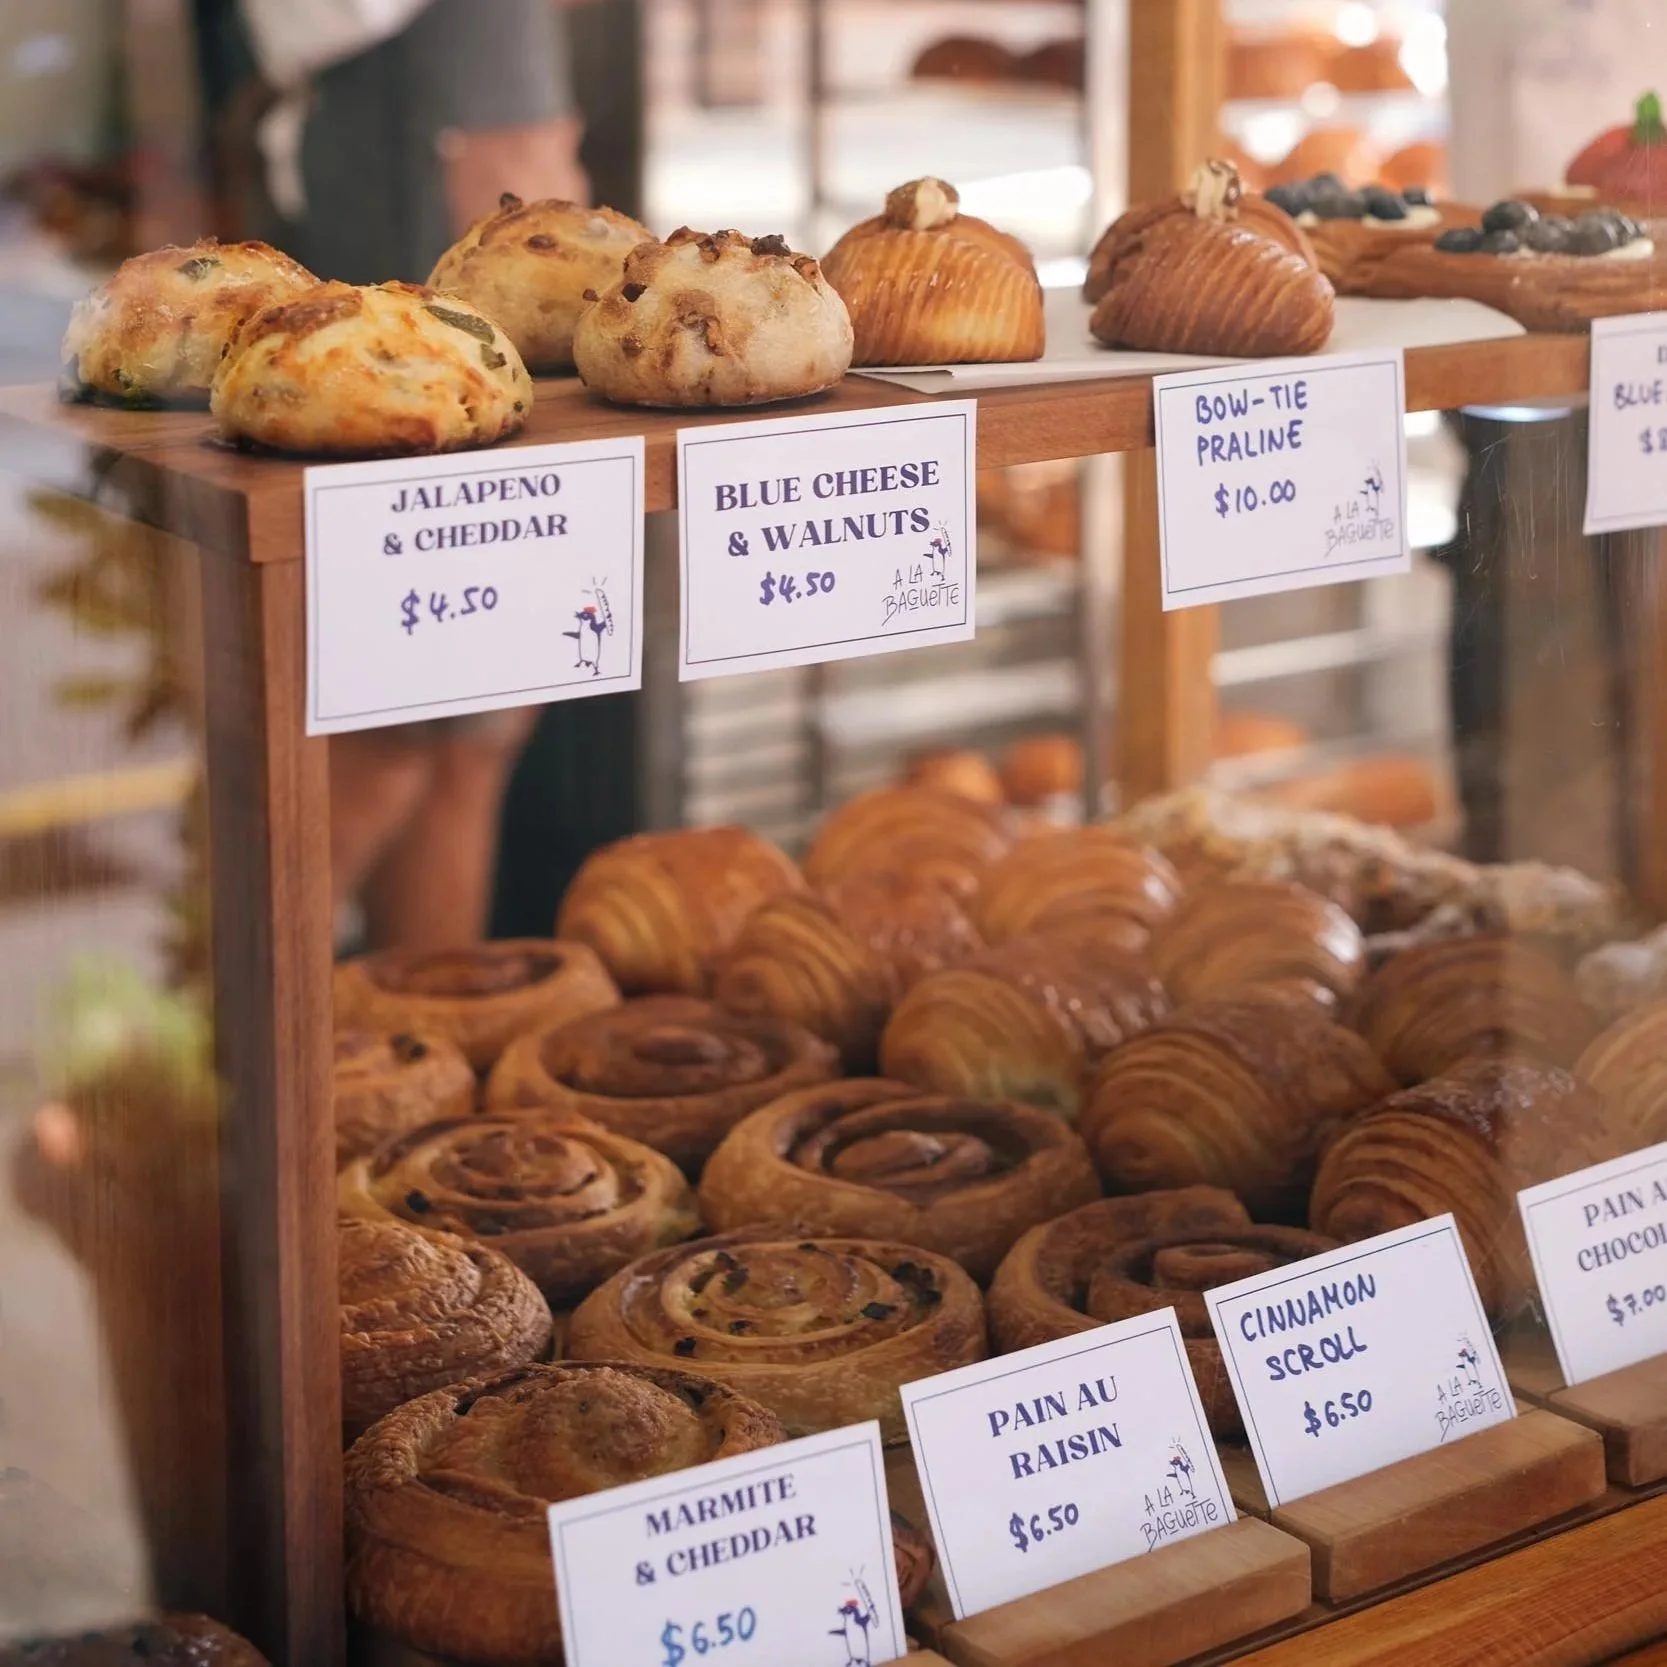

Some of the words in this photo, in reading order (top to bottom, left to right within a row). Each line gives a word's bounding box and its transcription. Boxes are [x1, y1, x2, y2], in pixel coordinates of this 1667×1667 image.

[1195, 381, 1308, 424] BOW-TIE
[1614, 380, 1667, 410] BLUE
[1197, 419, 1303, 466] PRALINE
[390, 473, 561, 513] JALAPENO
[715, 476, 801, 511] BLUE
[812, 460, 940, 498] CHEESE
[1214, 480, 1296, 518] $10.00
[383, 533, 403, 556] &
[414, 514, 568, 552] CHEDDAR
[728, 531, 749, 556] &
[761, 507, 930, 551] WALNUTS
[1334, 505, 1342, 522] A
[1346, 502, 1360, 520] LA
[759, 571, 836, 606] $4.50
[893, 568, 903, 589] A
[909, 564, 923, 584] LA
[401, 585, 498, 635] $4.50
[1583, 1188, 1645, 1227] PAIN
[1652, 1180, 1667, 1203] A
[1240, 1273, 1376, 1342] CINNAMON
[1606, 1284, 1666, 1327] $7.00
[1266, 1326, 1368, 1381] SCROLL
[987, 1391, 1068, 1437] PAIN
[1077, 1375, 1119, 1411] AU
[1437, 1384, 1445, 1402] A
[1449, 1376, 1462, 1397] LA
[1303, 1389, 1372, 1437] $6.50
[1008, 1423, 1123, 1479] RAISIN
[646, 1473, 797, 1538] MARMITE
[1144, 1494, 1155, 1516] A
[1158, 1485, 1172, 1508] LA
[635, 1560, 656, 1586] &
[666, 1514, 818, 1577] CHEDDAR
[1009, 1502, 1079, 1552] $6.50
[660, 1606, 757, 1667] $6.50
